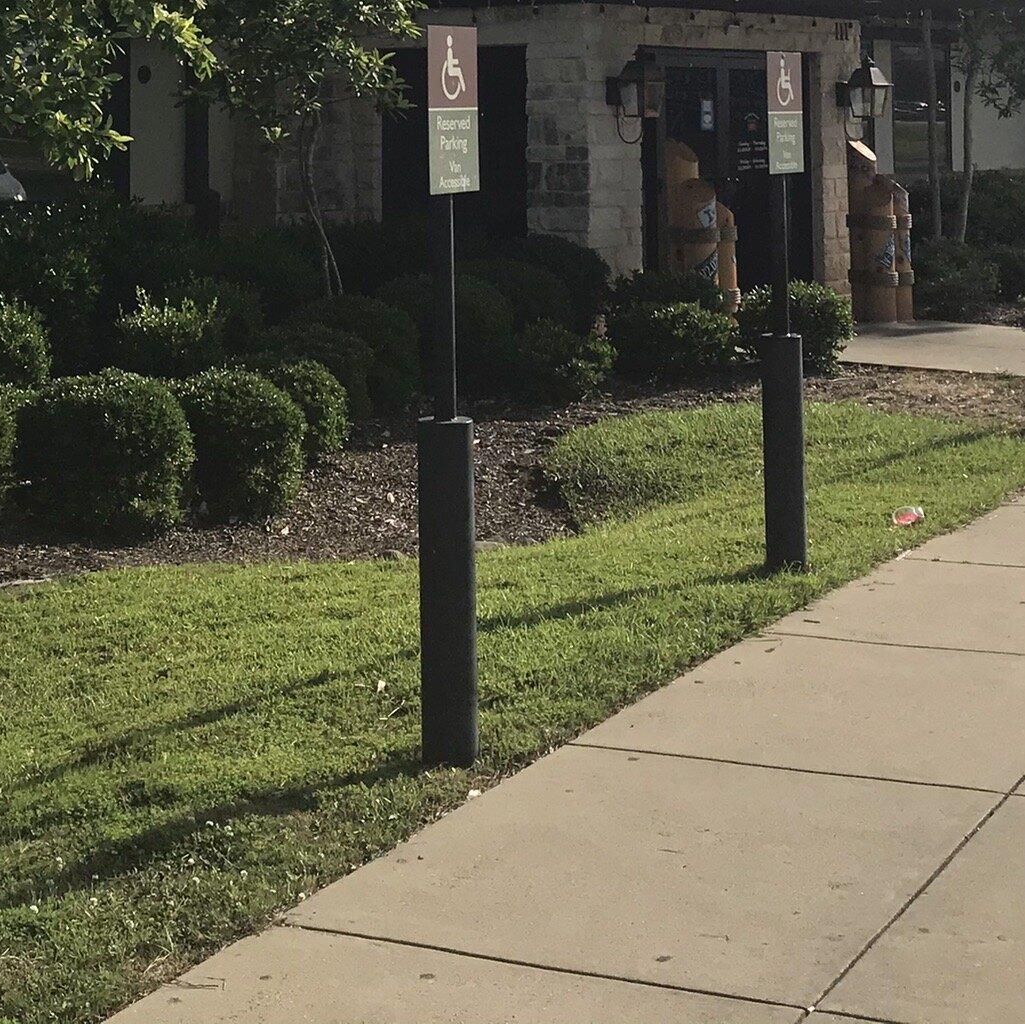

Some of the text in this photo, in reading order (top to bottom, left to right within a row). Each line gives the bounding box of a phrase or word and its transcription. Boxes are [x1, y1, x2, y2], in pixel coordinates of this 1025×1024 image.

[436, 115, 471, 130] Reserved
[440, 135, 468, 154] Parking
[449, 160, 462, 173] Van
